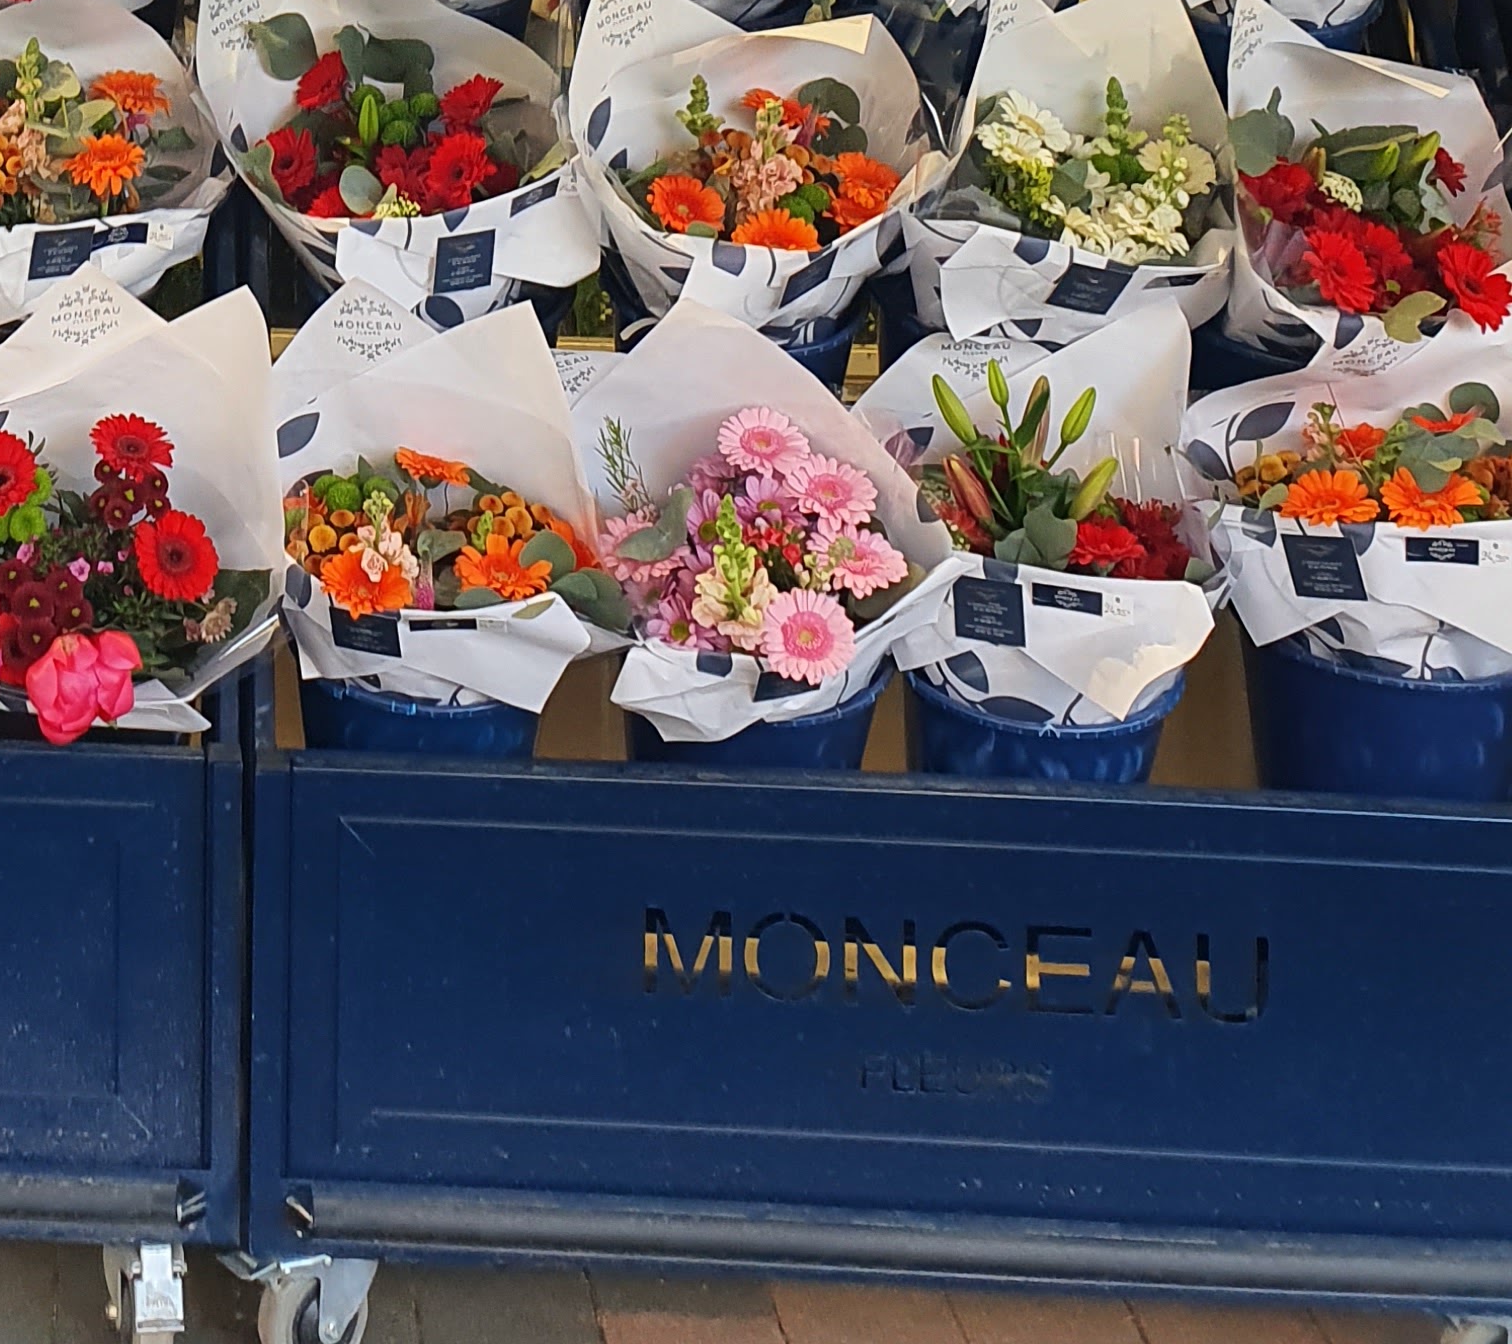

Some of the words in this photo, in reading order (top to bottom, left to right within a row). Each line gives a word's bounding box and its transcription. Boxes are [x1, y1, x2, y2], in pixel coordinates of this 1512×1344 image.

[210, 0, 262, 37] MONCEAU
[597, 0, 652, 29] MONCEAU
[51, 306, 120, 324] MONCEAU
[333, 320, 401, 331] MONCEAU
[941, 342, 1010, 352] MONCEAU
[643, 906, 1268, 1024] MONCEAU
